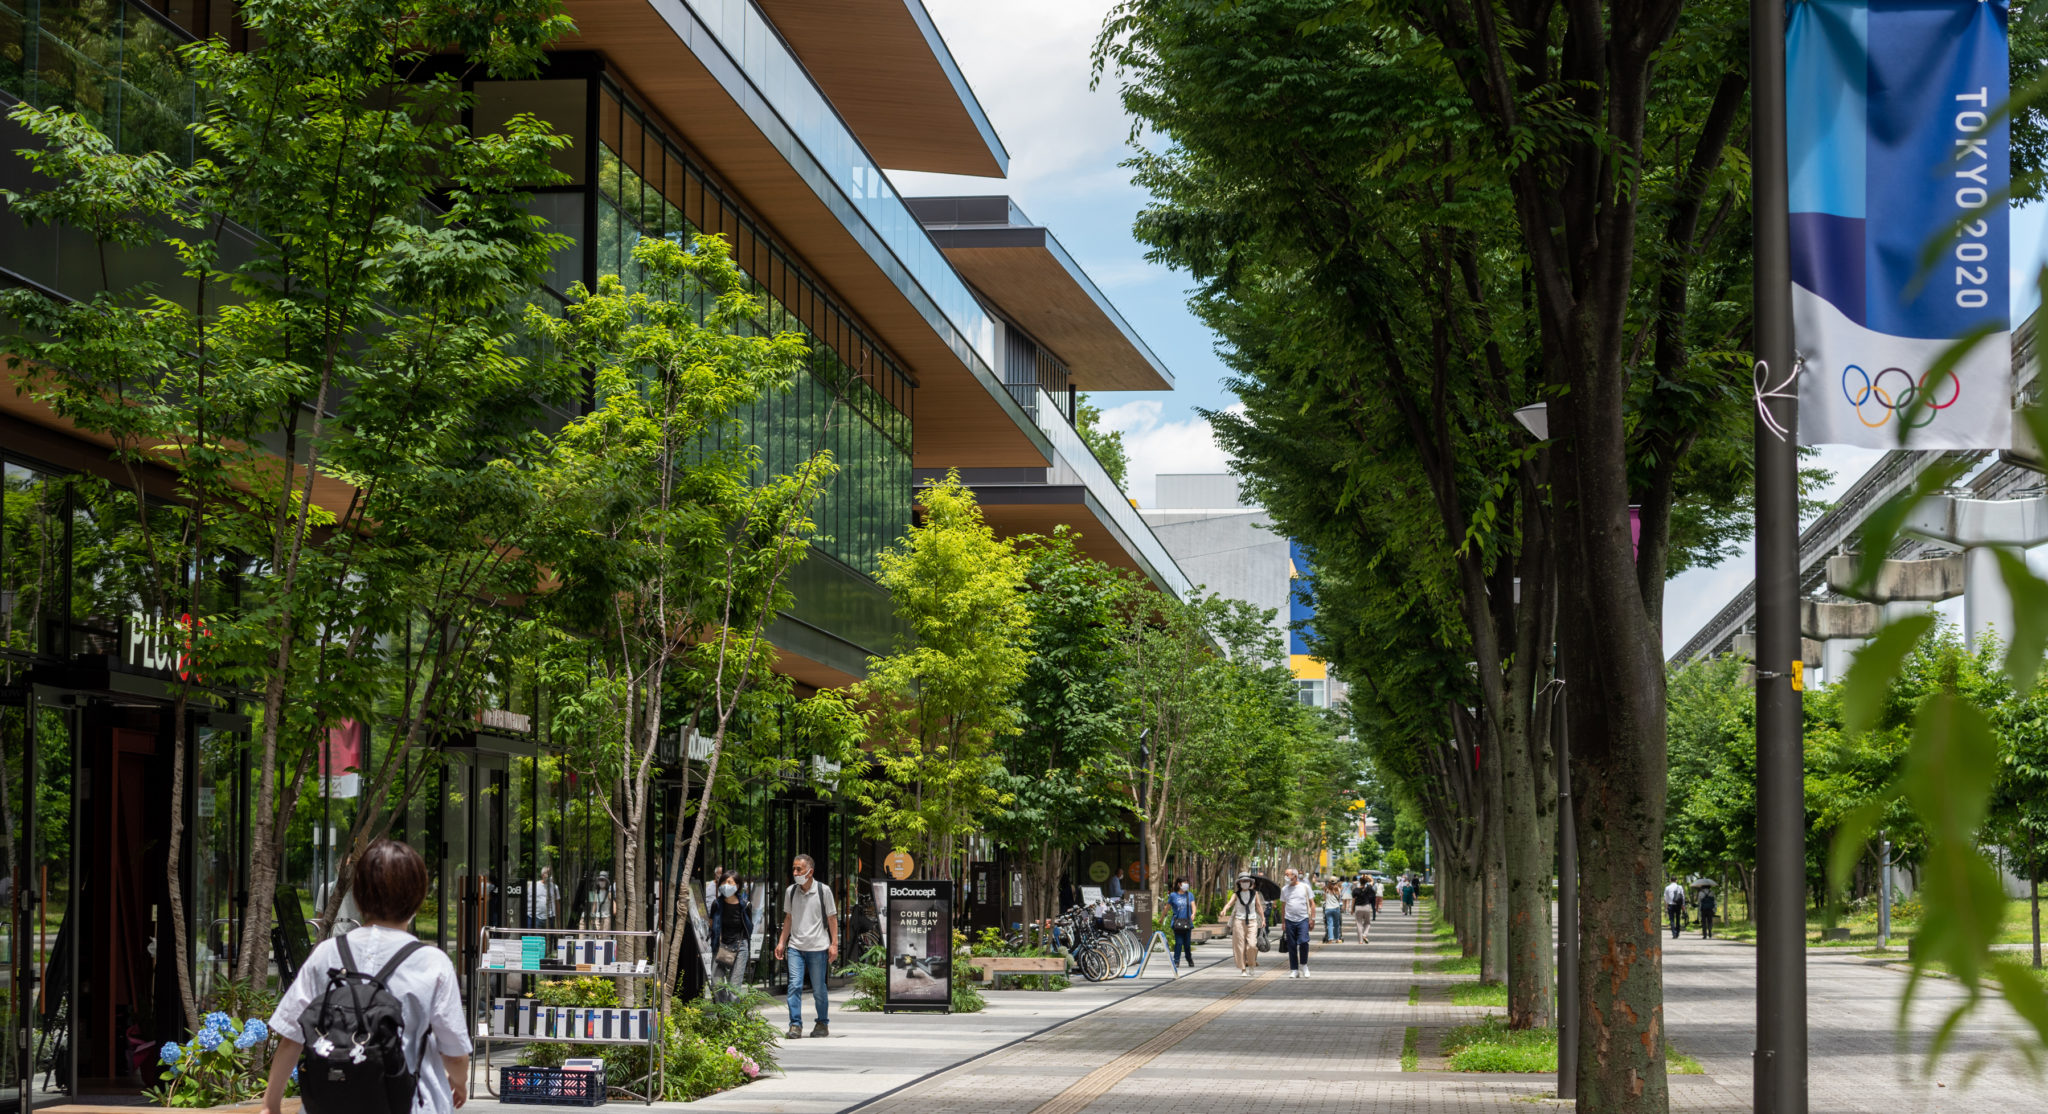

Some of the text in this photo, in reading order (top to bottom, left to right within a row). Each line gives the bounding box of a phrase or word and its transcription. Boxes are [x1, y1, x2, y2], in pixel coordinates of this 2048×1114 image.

[1955, 86, 1988, 308] TOKYO 2020
[890, 887, 937, 899] BoConcept
